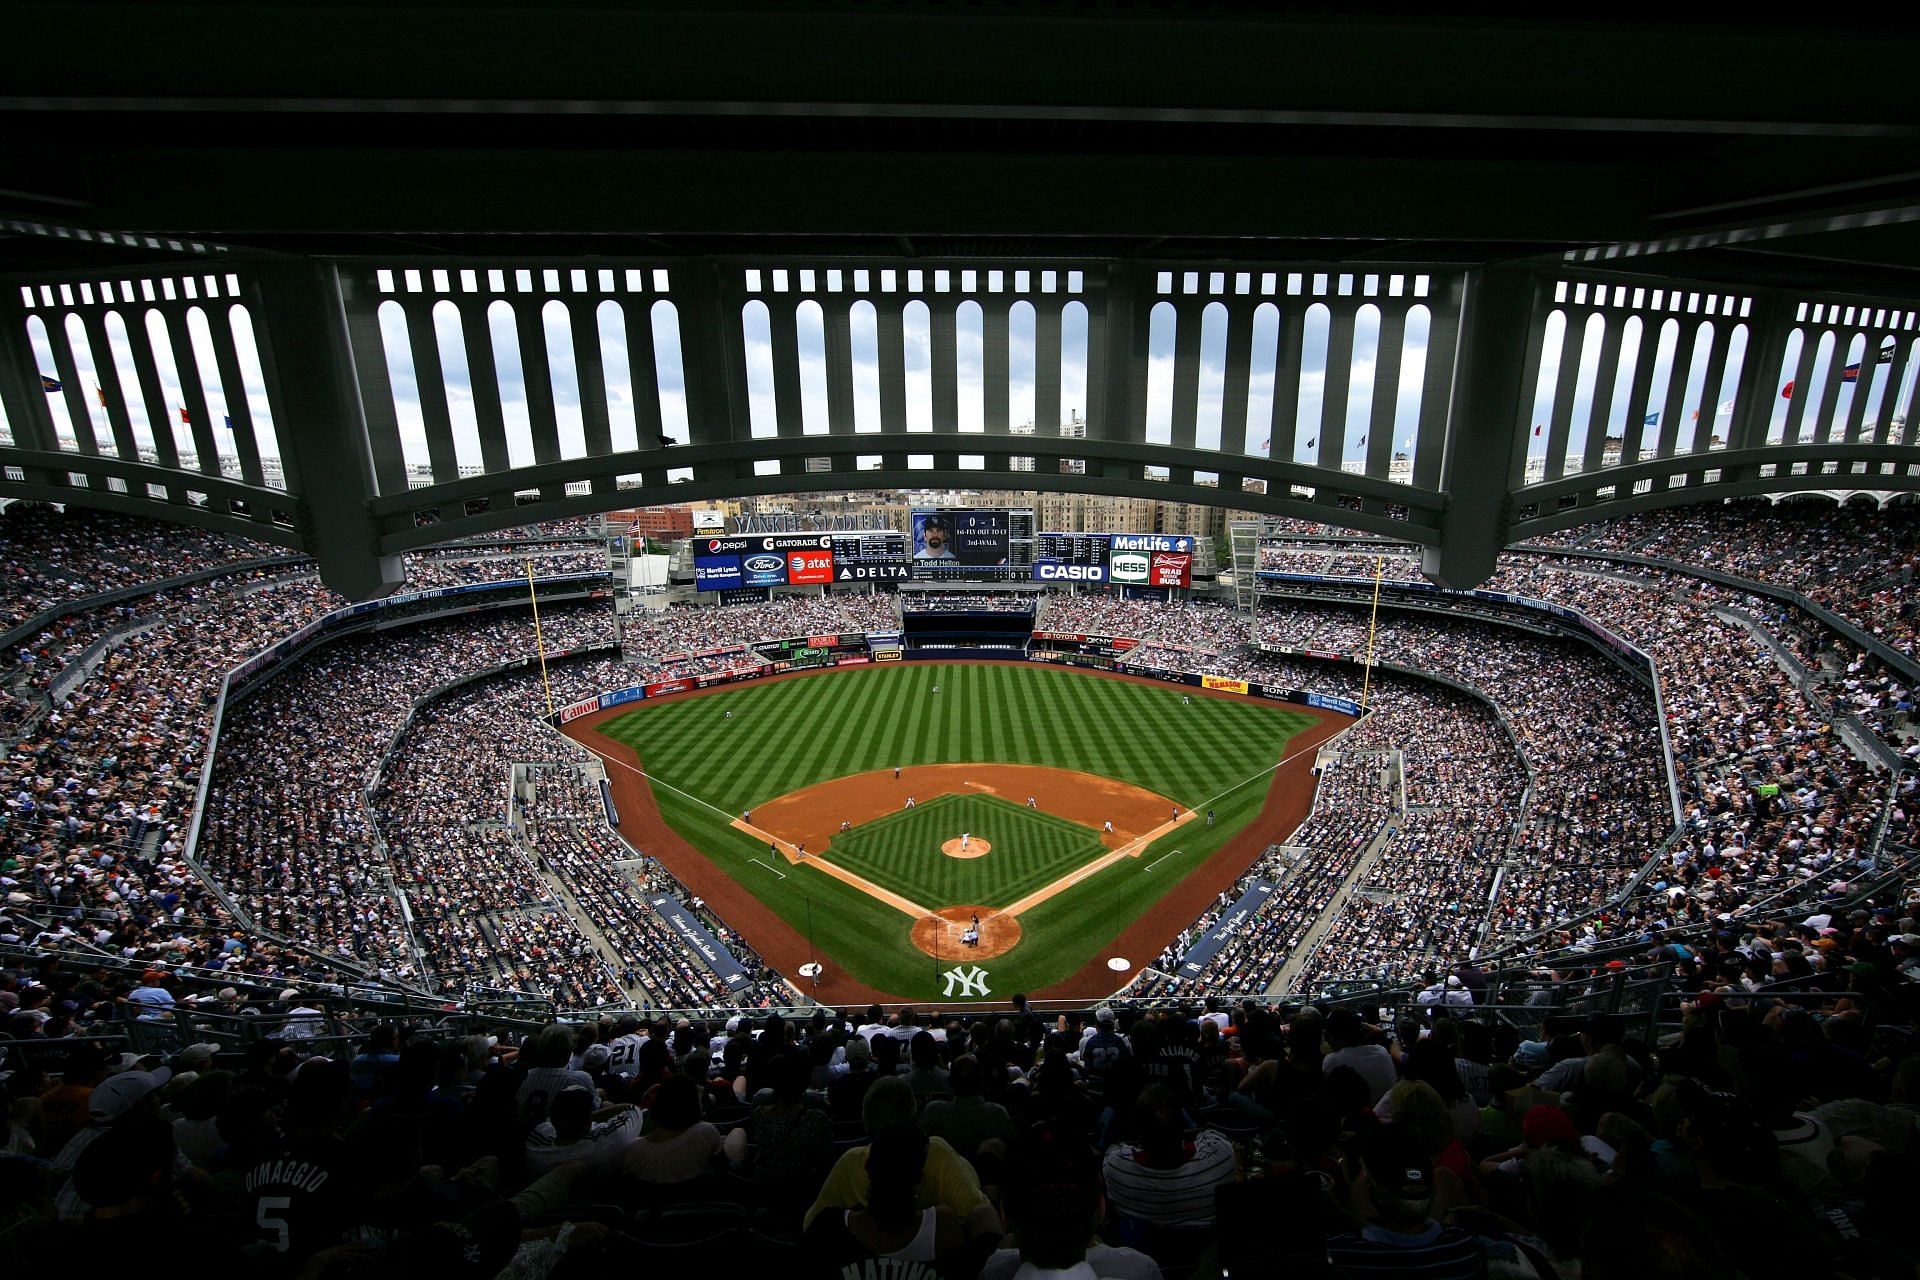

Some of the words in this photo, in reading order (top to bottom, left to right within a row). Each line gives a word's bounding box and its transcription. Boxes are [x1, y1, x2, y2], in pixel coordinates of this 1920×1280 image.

[733, 514, 803, 534] YANKEE
[811, 514, 889, 532] STADIUM
[969, 517, 976, 527] 0
[991, 517, 996, 527] 1
[722, 540, 747, 550] pepsi
[776, 539, 818, 548] GATORADE
[1114, 536, 1170, 552] MetLife
[753, 559, 776, 569] Ford
[807, 557, 831, 569] at&t
[1114, 562, 1146, 573] HESS
[856, 566, 908, 578] DELTA
[1040, 565, 1103, 580] CASIO
[1052, 633, 1078, 641] TOYOTA
[1088, 638, 1113, 646] DKNY
[1262, 686, 1292, 696] SONY
[1321, 696, 1338, 704] Merrill
[1338, 700, 1352, 708] Lynch
[561, 700, 598, 722] Canon
[942, 966, 992, 998] NY
[612, 1044, 636, 1066] 21
[1159, 1045, 1200, 1063] LLIAMS
[245, 1159, 329, 1194] DIMAGGIO
[255, 1196, 292, 1252] 5
